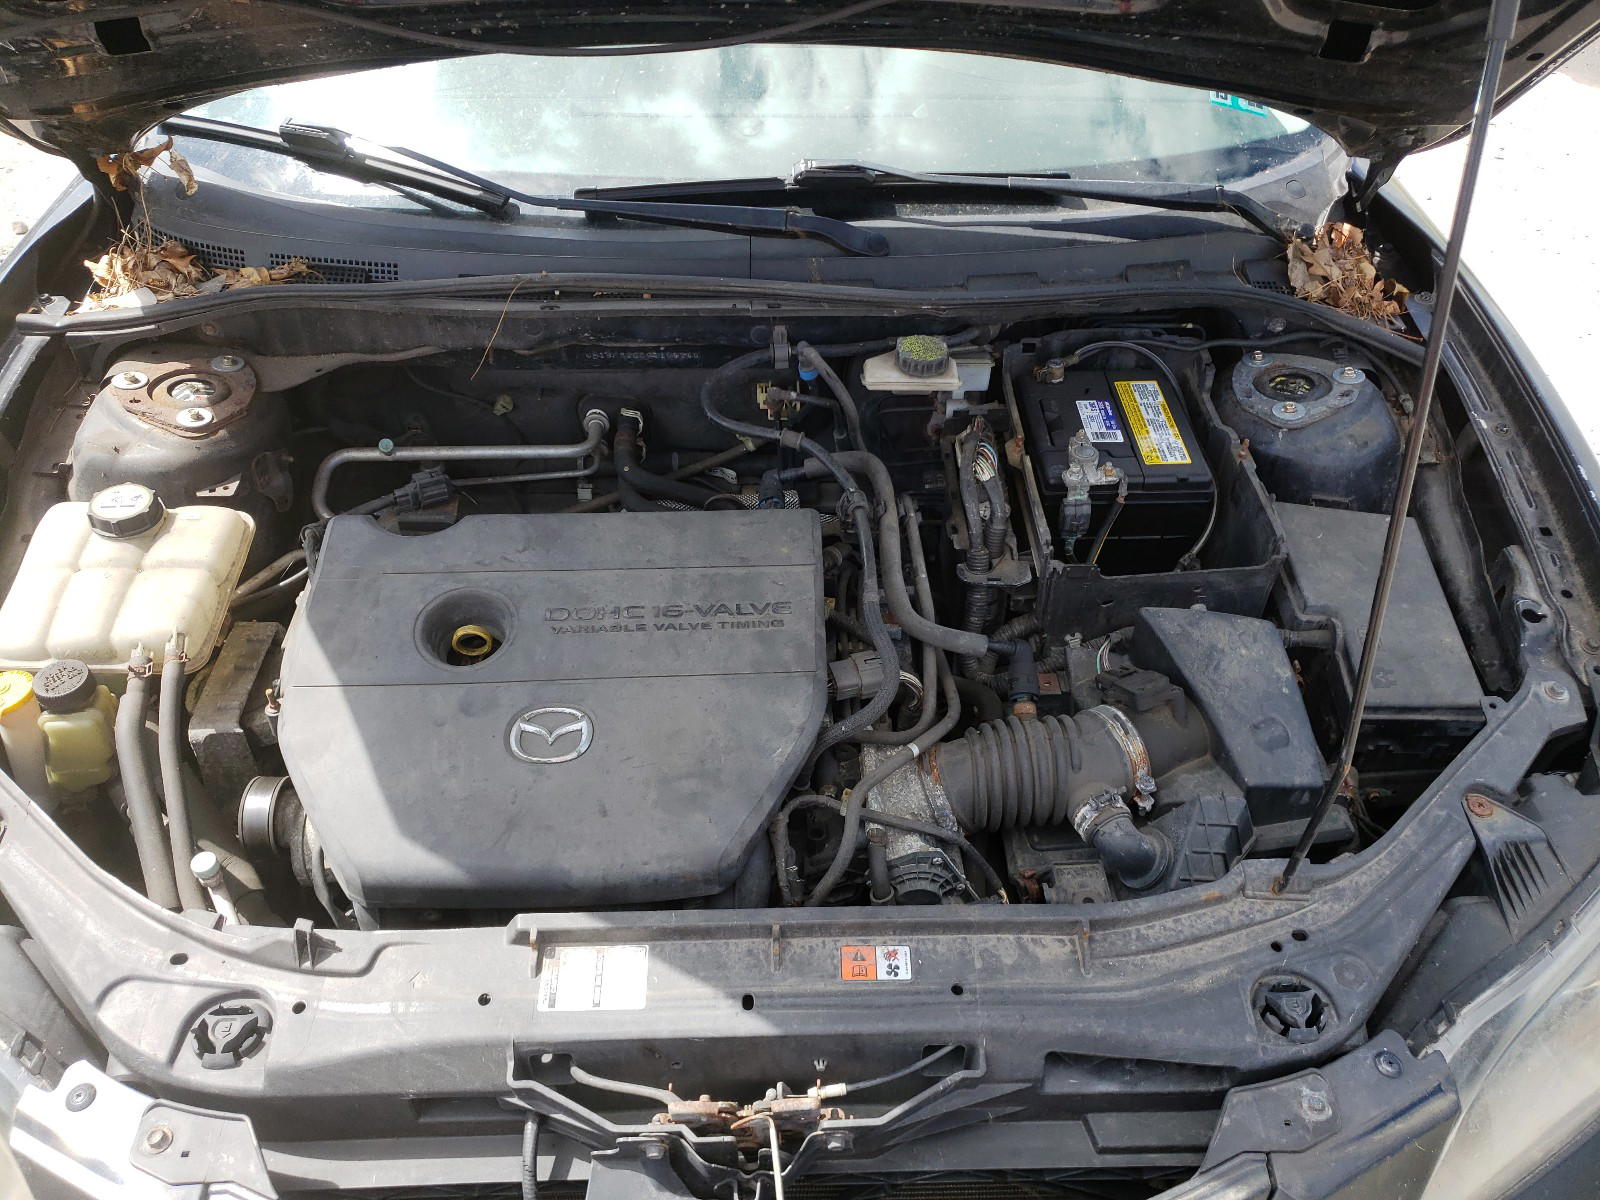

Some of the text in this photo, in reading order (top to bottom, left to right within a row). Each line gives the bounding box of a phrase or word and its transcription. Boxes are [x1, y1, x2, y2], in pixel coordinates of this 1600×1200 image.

[544, 602, 792, 621] DOHC 16-VALVE
[551, 619, 785, 635] VARIABLE VALVE TIMING
